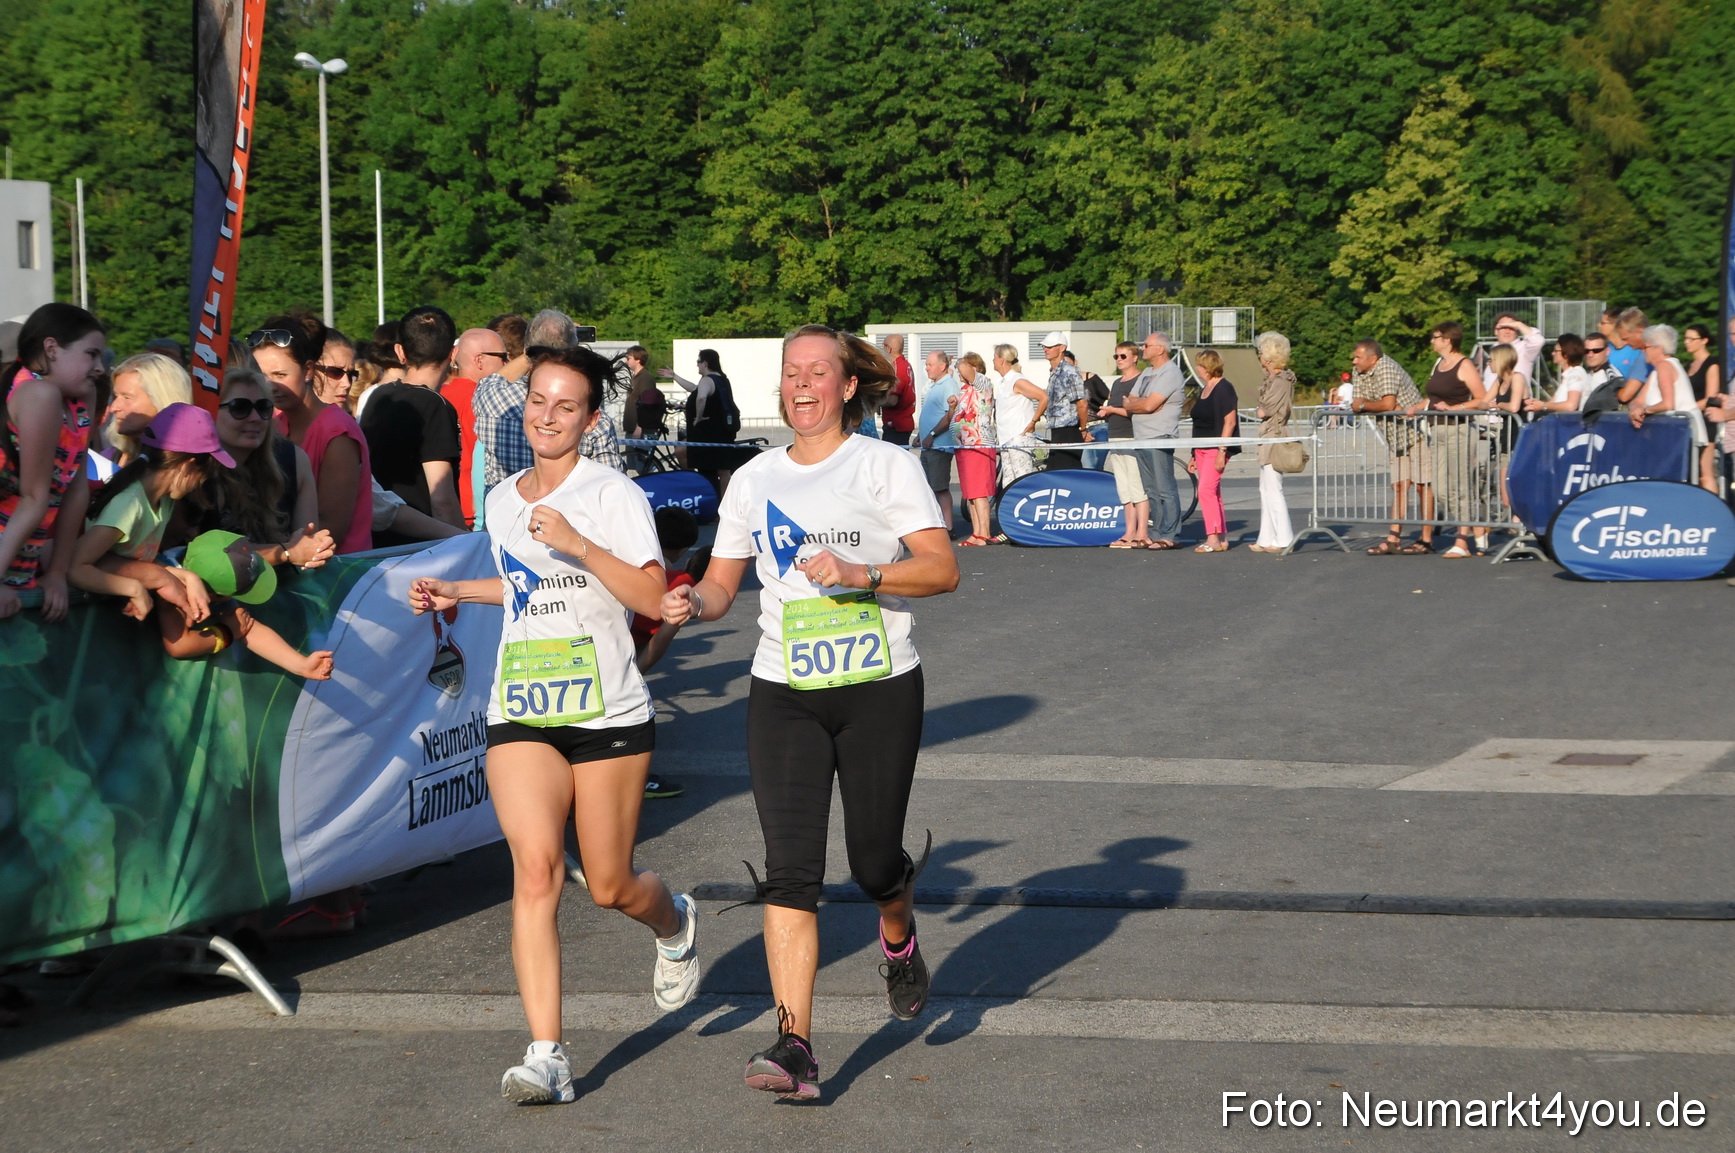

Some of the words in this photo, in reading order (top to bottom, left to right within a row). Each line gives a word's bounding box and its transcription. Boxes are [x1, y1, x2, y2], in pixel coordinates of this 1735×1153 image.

[1563, 464, 1650, 495] Fisch
[1034, 502, 1124, 522] Fischer
[1042, 521, 1117, 530] AUTOMOBILE
[1599, 524, 1716, 547] Fischer
[752, 530, 763, 553] T
[773, 525, 861, 550] Running
[1610, 547, 1708, 559] AUTOMOBILE
[521, 600, 567, 617] Team
[787, 603, 809, 614] 2014
[791, 633, 883, 677] 5072
[506, 678, 593, 717] 5077
